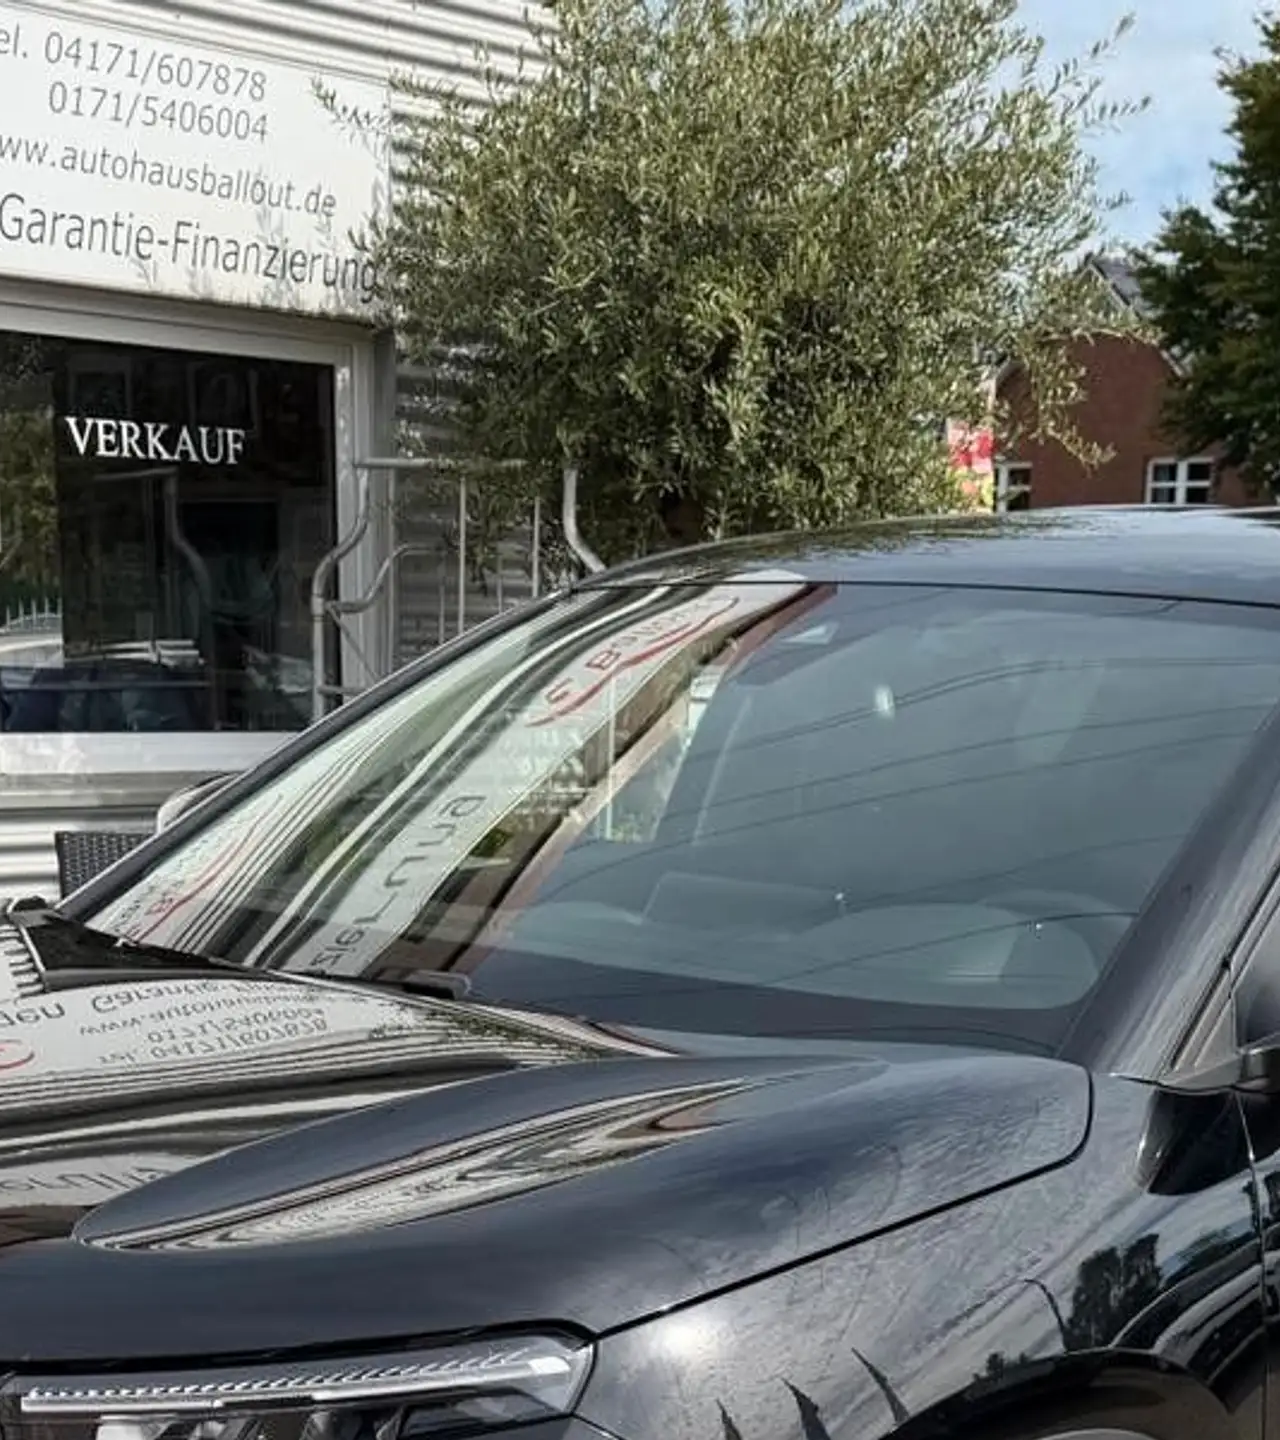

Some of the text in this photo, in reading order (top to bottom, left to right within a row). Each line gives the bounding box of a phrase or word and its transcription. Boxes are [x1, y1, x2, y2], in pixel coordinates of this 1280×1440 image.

[43, 31, 268, 103] 04171/607878
[48, 81, 269, 143] 0171/5406004
[64, 415, 247, 465] VERKAUF
